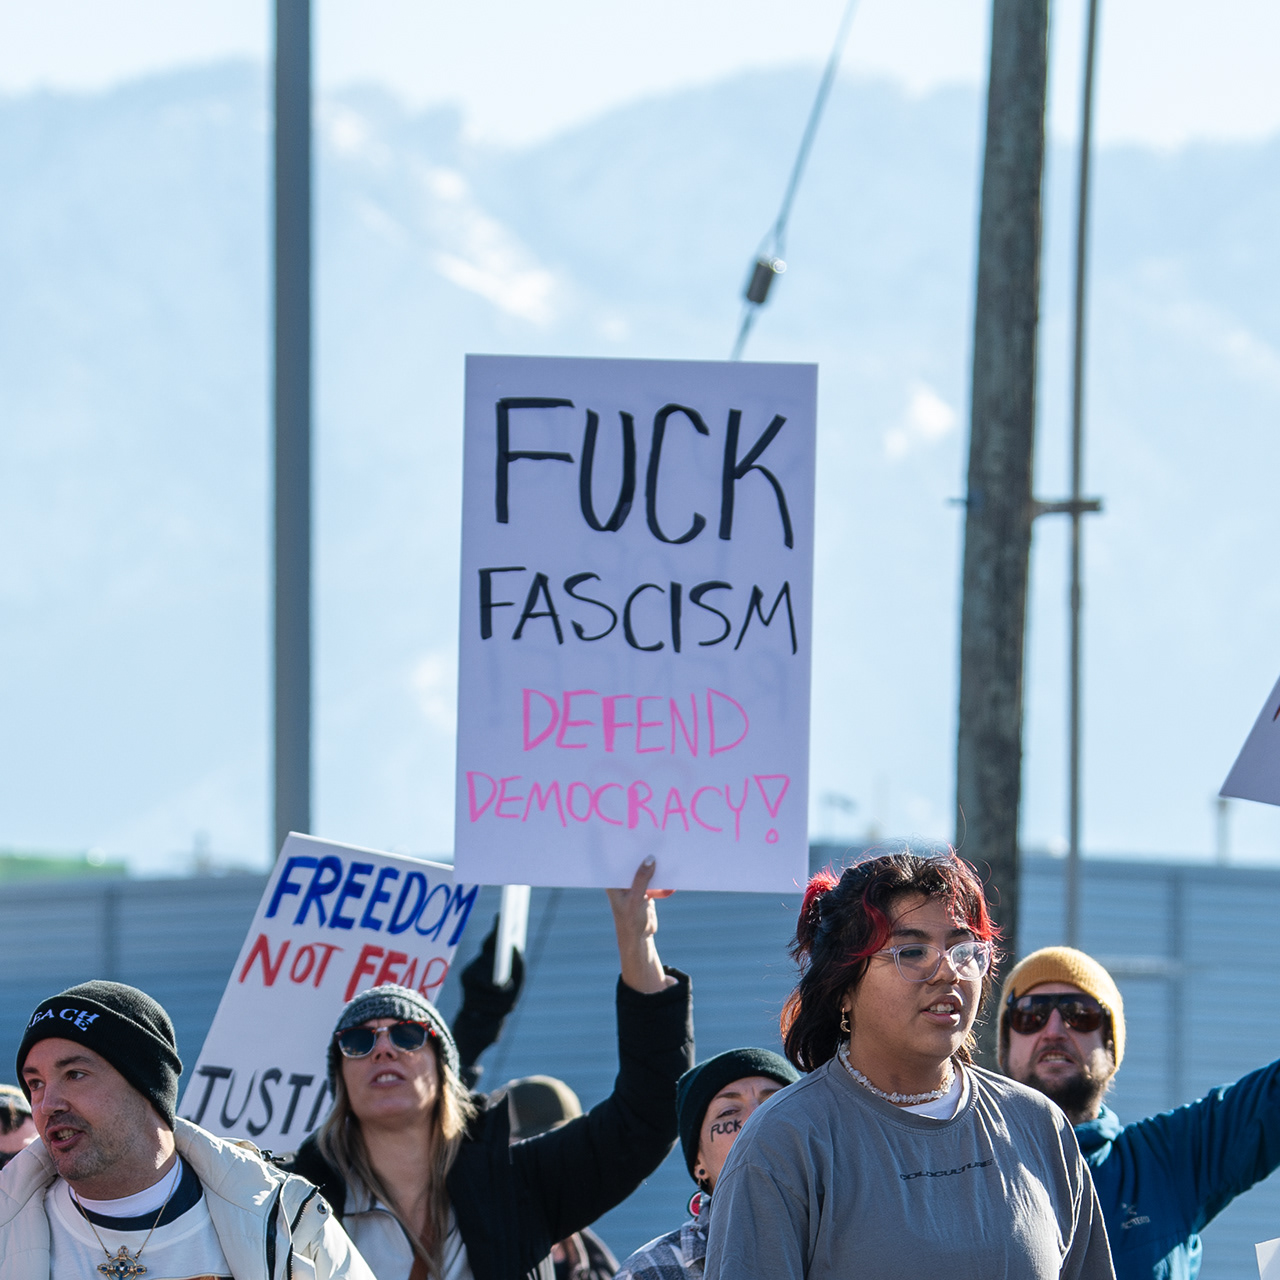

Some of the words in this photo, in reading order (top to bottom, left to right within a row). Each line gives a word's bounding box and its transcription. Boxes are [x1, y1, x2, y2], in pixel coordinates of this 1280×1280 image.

[495, 397, 794, 549] FUCK
[478, 566, 798, 655] FASCISM
[521, 687, 749, 757] DEFEND
[465, 771, 791, 845] DEMOCRACY!
[265, 855, 480, 947] FREEDOM
[239, 933, 345, 989] NOT
[343, 943, 449, 1004] FEAR
[710, 1119, 742, 1143] FUCK
